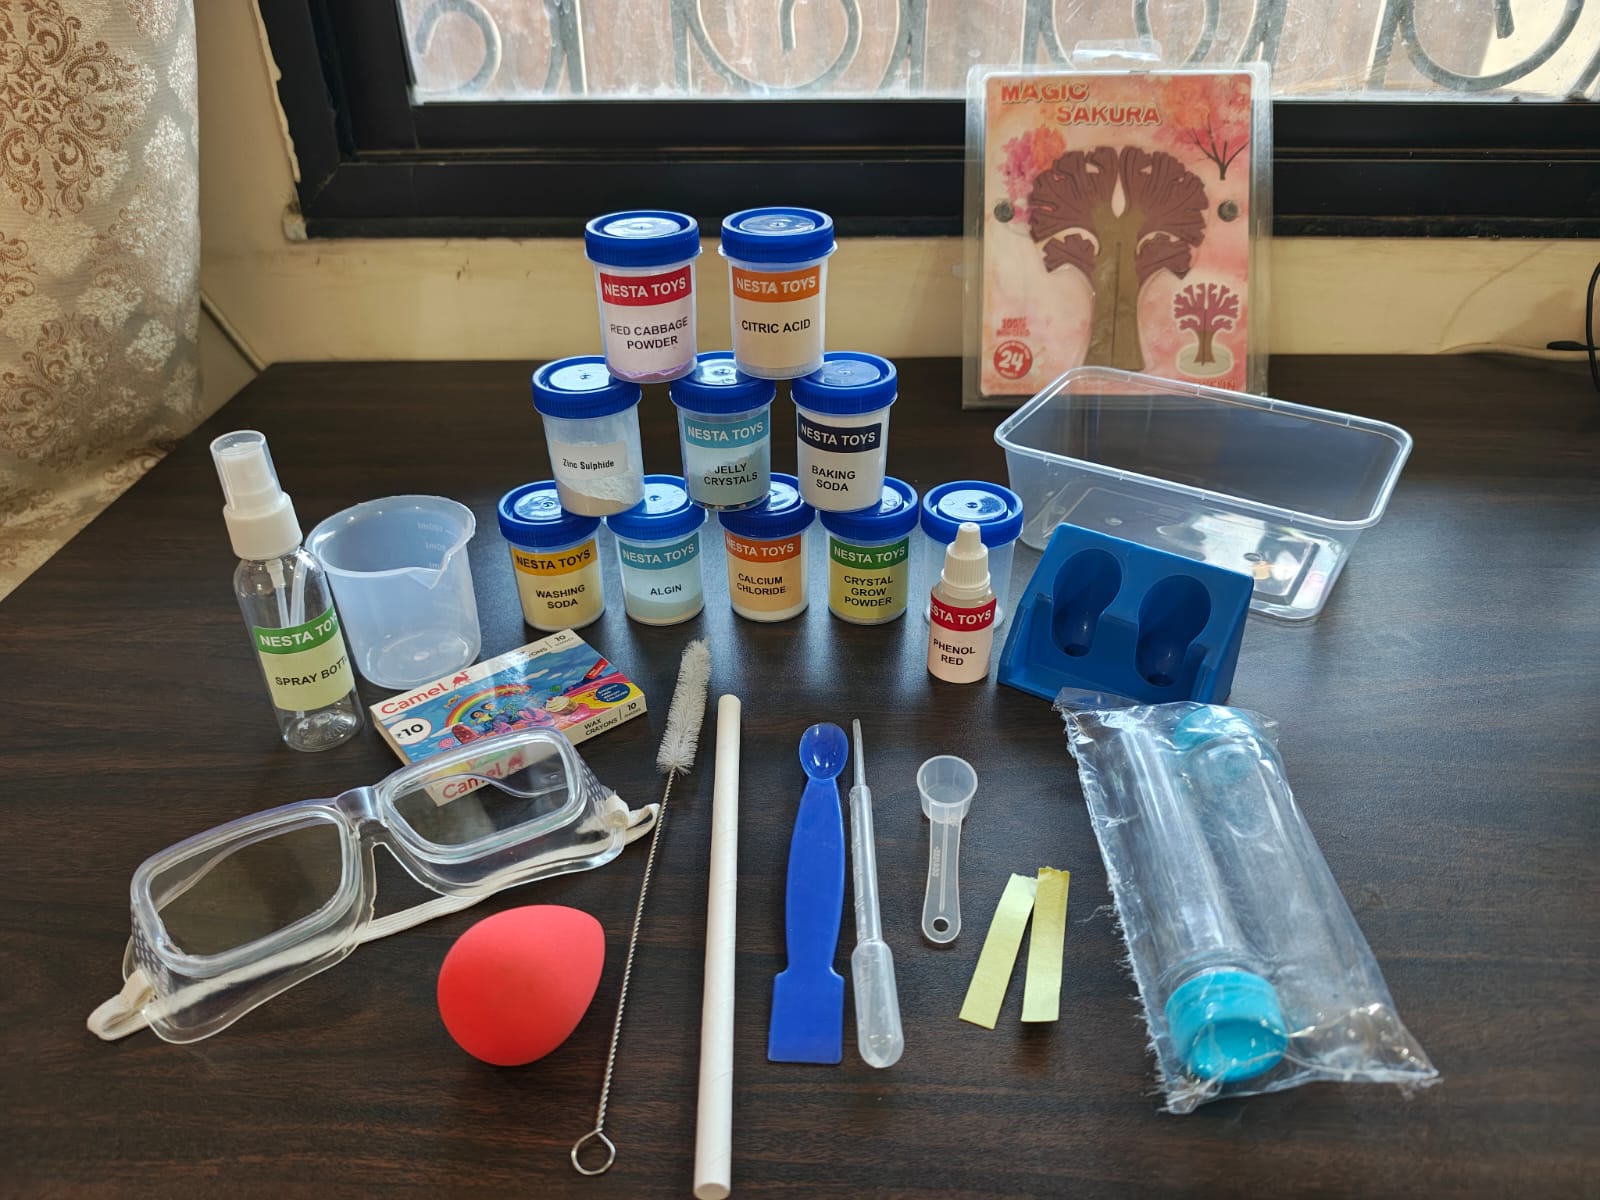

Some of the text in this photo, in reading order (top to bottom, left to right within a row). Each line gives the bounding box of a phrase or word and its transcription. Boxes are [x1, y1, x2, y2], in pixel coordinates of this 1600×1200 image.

[1001, 82, 1089, 103] MAGIC
[1056, 104, 1162, 126] SAKURA
[604, 277, 686, 298] NESTA TOYS
[736, 276, 816, 294] NESTA TOYS
[610, 316, 688, 336] RED CABBAGE
[741, 318, 811, 334] CITRIC ACID
[627, 335, 678, 350] POWDER
[998, 350, 1024, 371] 24
[687, 421, 764, 442] NESTA TOYS
[801, 424, 876, 447] NESTA TOYS
[562, 457, 615, 471] Zinc Sulphide
[714, 463, 747, 475] JELLY
[811, 464, 856, 480] BAKING
[703, 471, 758, 486] CRYSTALS
[816, 479, 849, 492] SODA
[623, 543, 695, 564] NESTA TOYS
[726, 536, 794, 557] NESTA TOYS
[516, 549, 591, 570] NESTA TOYS
[833, 546, 905, 564] NESTA TOYS
[738, 573, 783, 585] CALCIUM
[844, 575, 893, 586] CRYSTAL
[536, 584, 585, 600] WASHING
[650, 584, 682, 596] ALGIN
[736, 582, 786, 596] CHLORIDE
[850, 586, 886, 597] GROW
[547, 598, 578, 609] SODA
[844, 596, 892, 608] POWDER
[930, 602, 991, 625] STA TOYS
[259, 631, 314, 647] NESTA
[933, 638, 976, 655] PHENOL
[940, 654, 964, 666] RED
[275, 656, 347, 686] SPRAY BOTT
[381, 682, 448, 715] Camel
[627, 702, 637, 711] 10
[584, 719, 601, 730] WAX
[585, 717, 618, 736] CRAYONS
